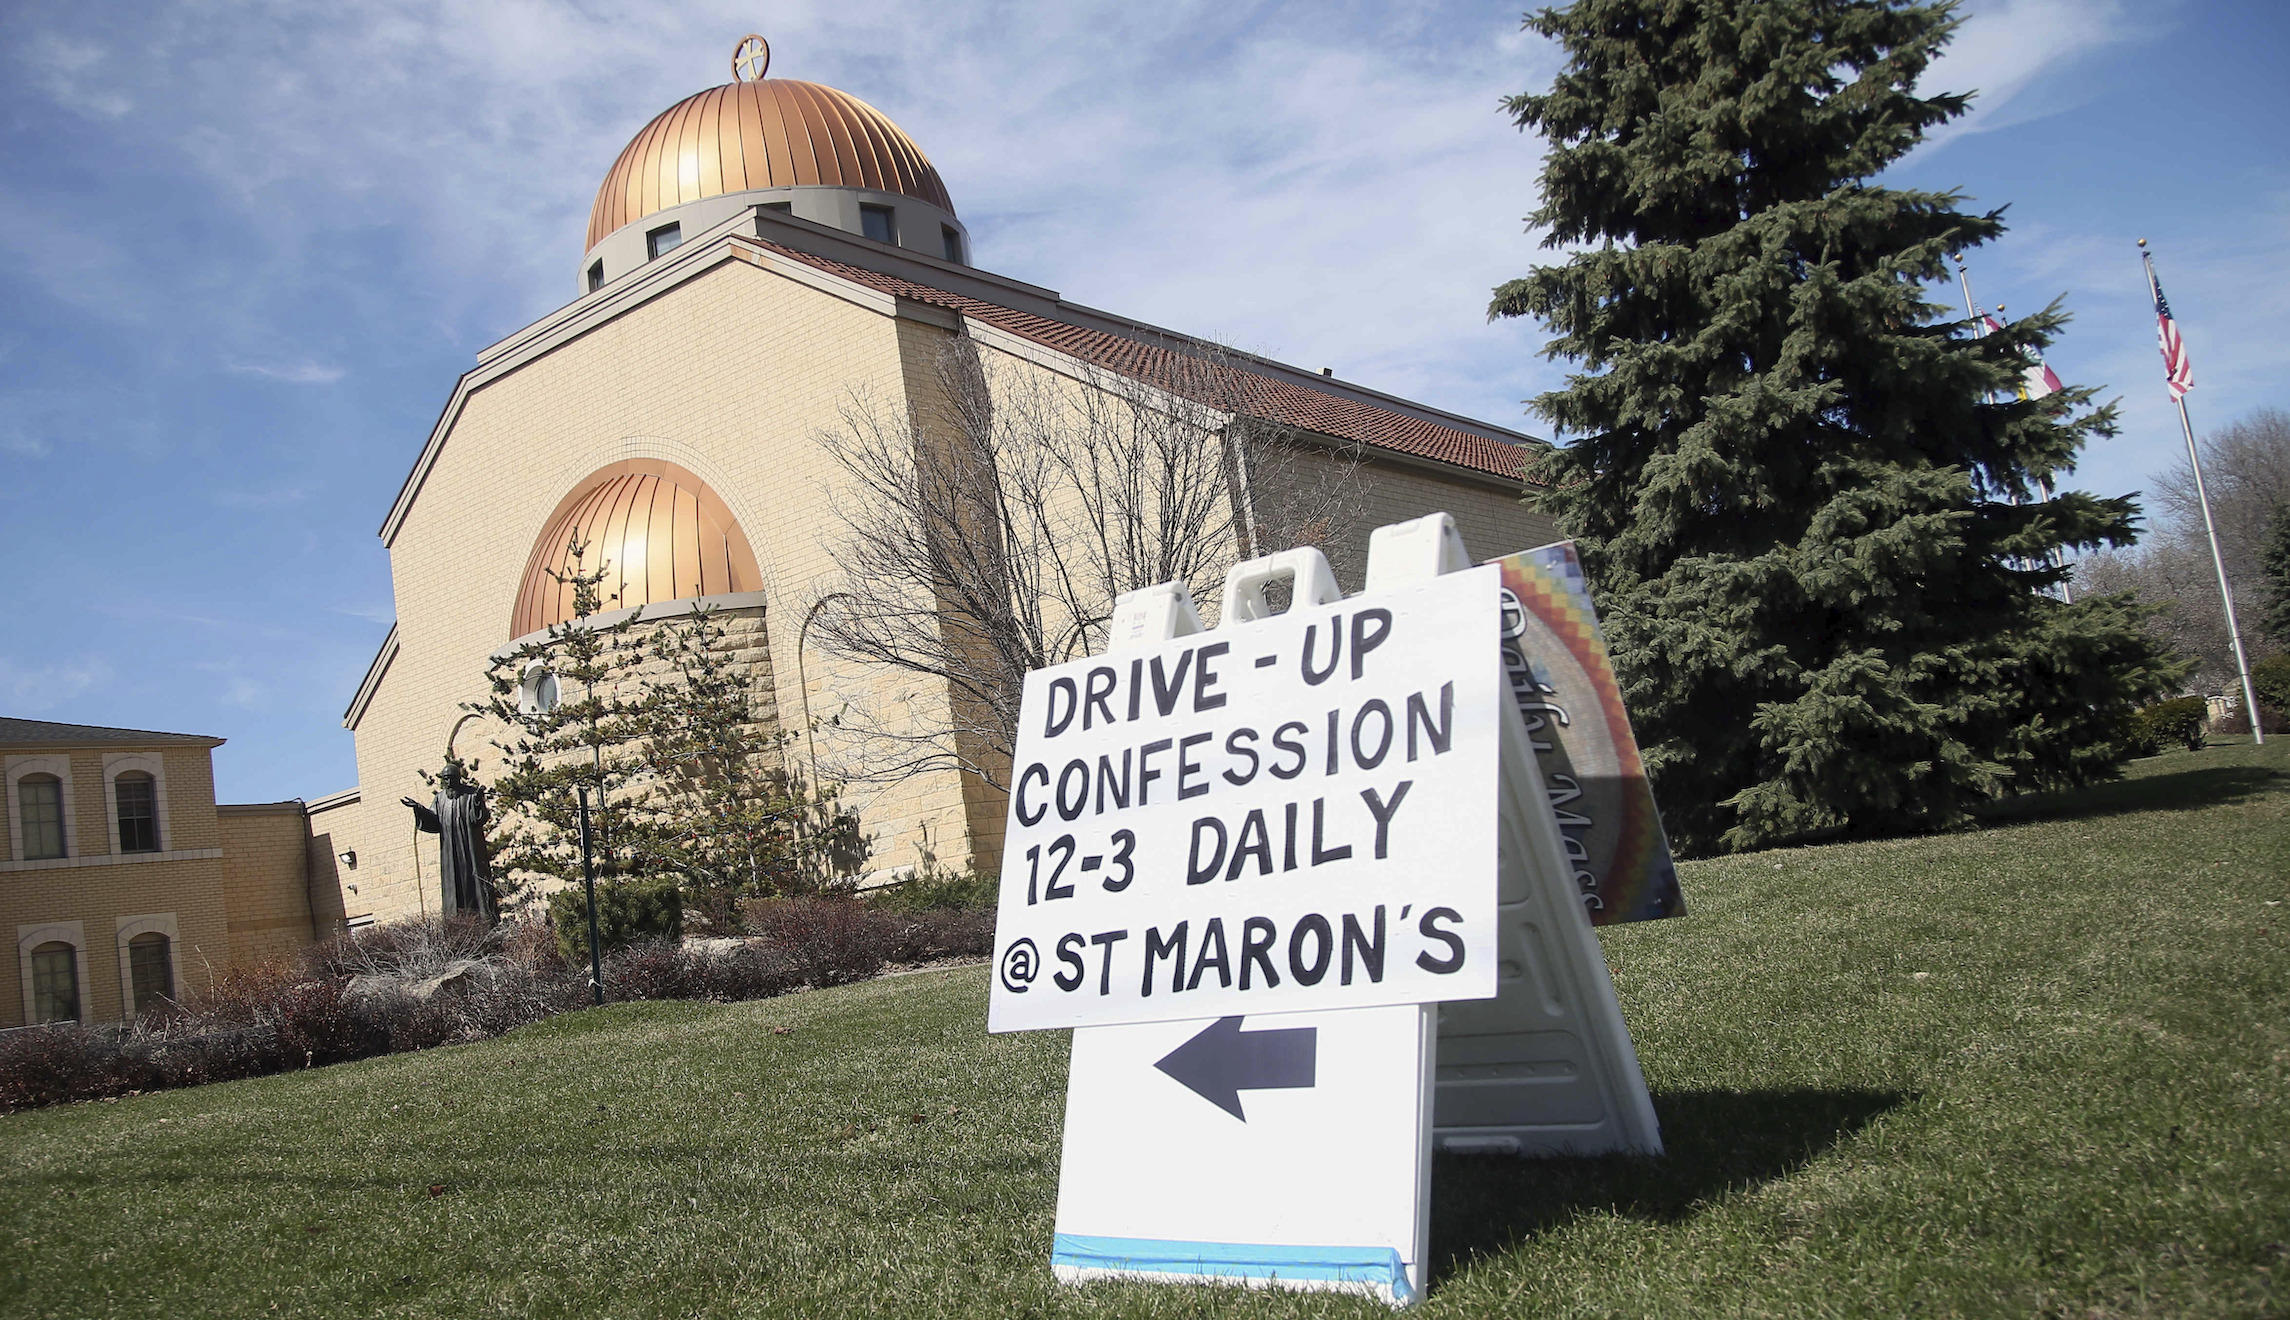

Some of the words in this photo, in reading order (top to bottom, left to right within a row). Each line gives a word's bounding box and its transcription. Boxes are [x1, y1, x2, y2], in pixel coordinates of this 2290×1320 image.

[1044, 641, 1230, 739] DRIVE
[1301, 608, 1393, 686] UP
[1017, 680, 1454, 828] CONFESSION
[1026, 828, 1136, 906] 12-3
[1186, 780, 1413, 886] DAILY
[1140, 904, 1467, 998] MARON'S
